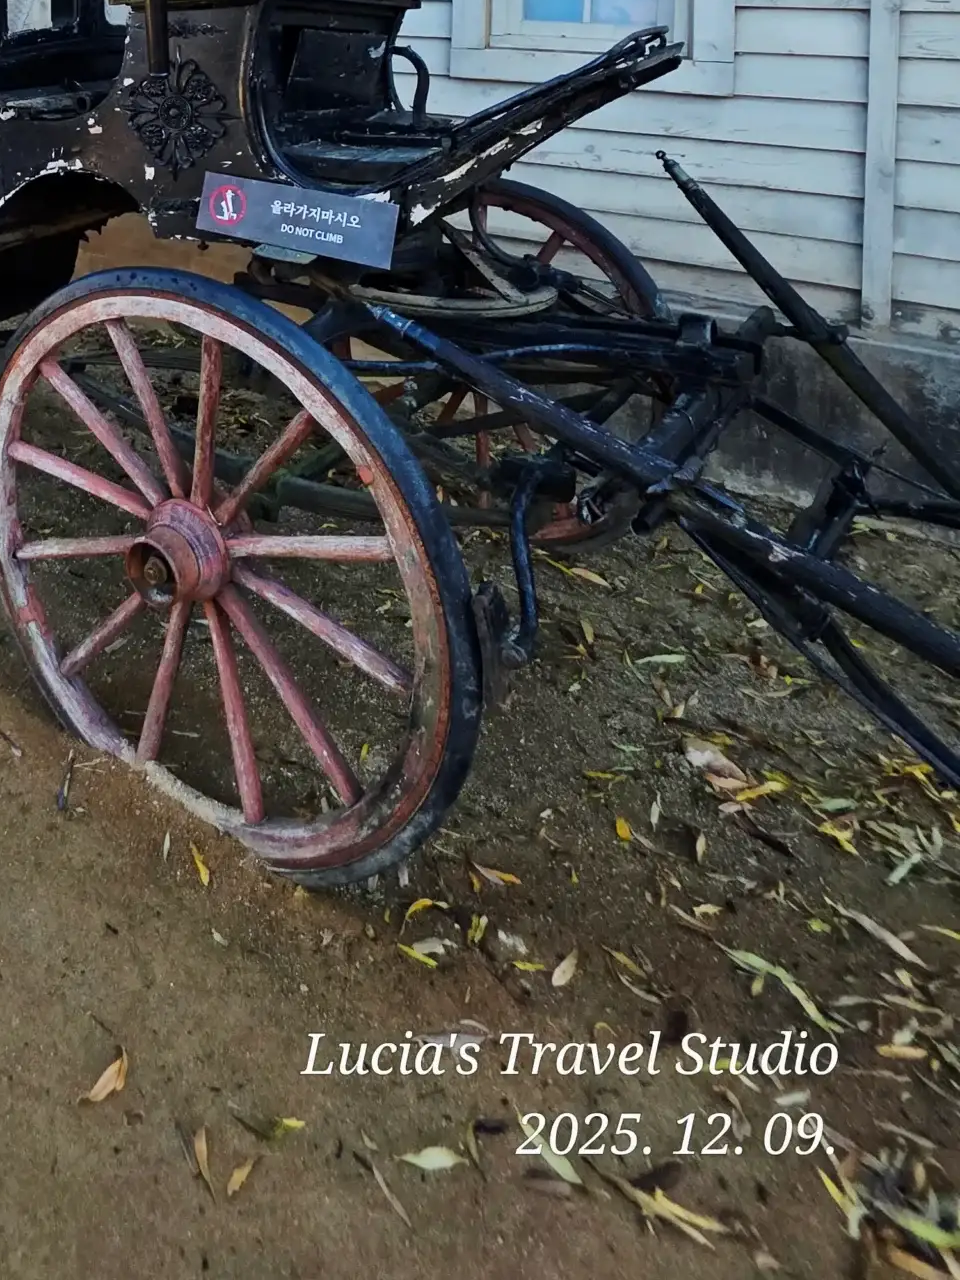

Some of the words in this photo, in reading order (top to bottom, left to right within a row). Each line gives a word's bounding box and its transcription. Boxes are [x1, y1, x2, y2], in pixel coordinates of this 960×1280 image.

[270, 200, 362, 229] 올라가지마시오
[280, 223, 295, 234] DO
[295, 226, 314, 238] NOT
[315, 230, 344, 244] CLIMB
